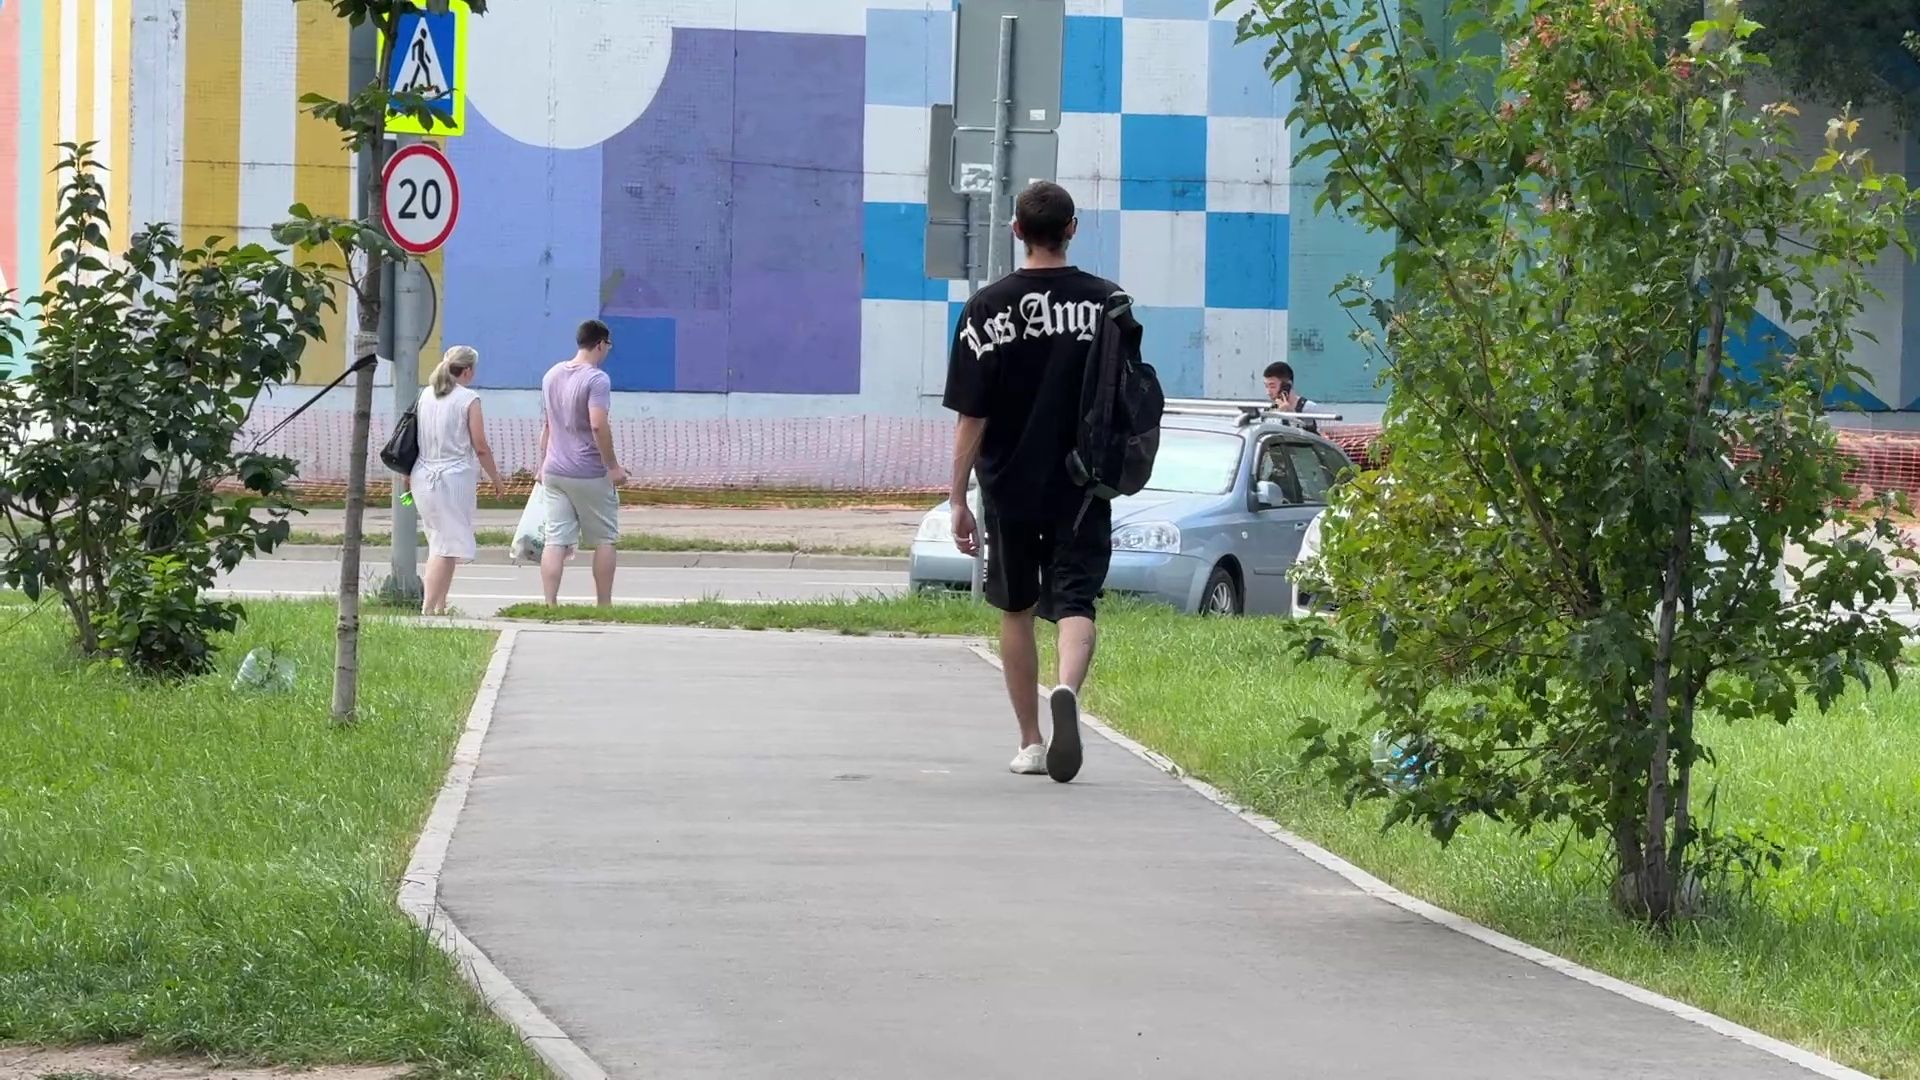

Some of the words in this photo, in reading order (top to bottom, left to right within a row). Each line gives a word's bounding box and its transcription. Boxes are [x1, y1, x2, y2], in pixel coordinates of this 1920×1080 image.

[398, 178, 441, 220] 20
[959, 305, 1017, 361] Los
[1019, 290, 1104, 341] Ang
